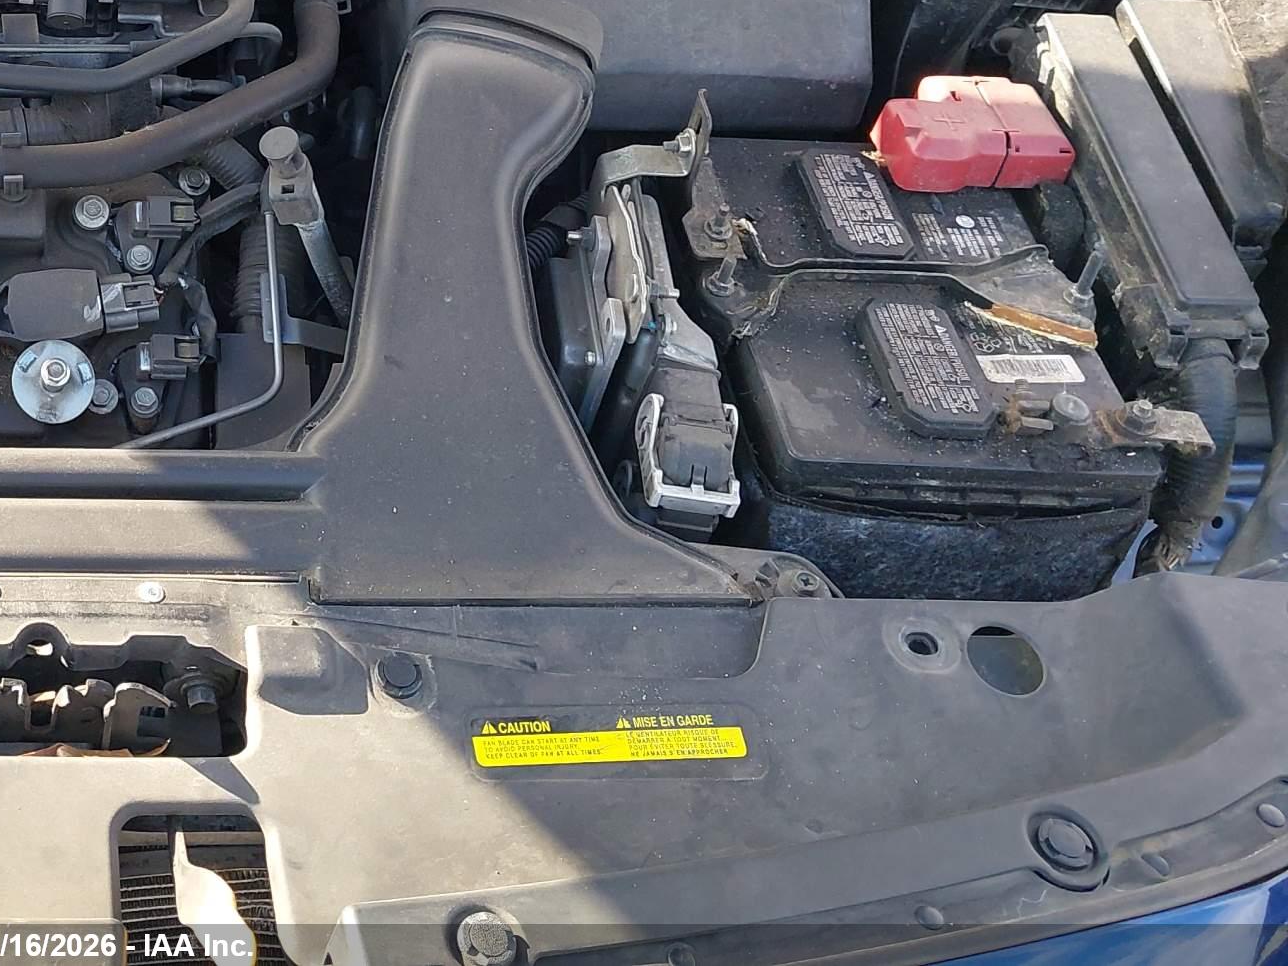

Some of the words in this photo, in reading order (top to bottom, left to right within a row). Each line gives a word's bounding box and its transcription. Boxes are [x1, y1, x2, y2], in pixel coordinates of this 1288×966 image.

[498, 721, 551, 734] CAUTION
[632, 716, 658, 728] MISE
[660, 715, 675, 727] EN
[677, 714, 713, 726] GARDE
